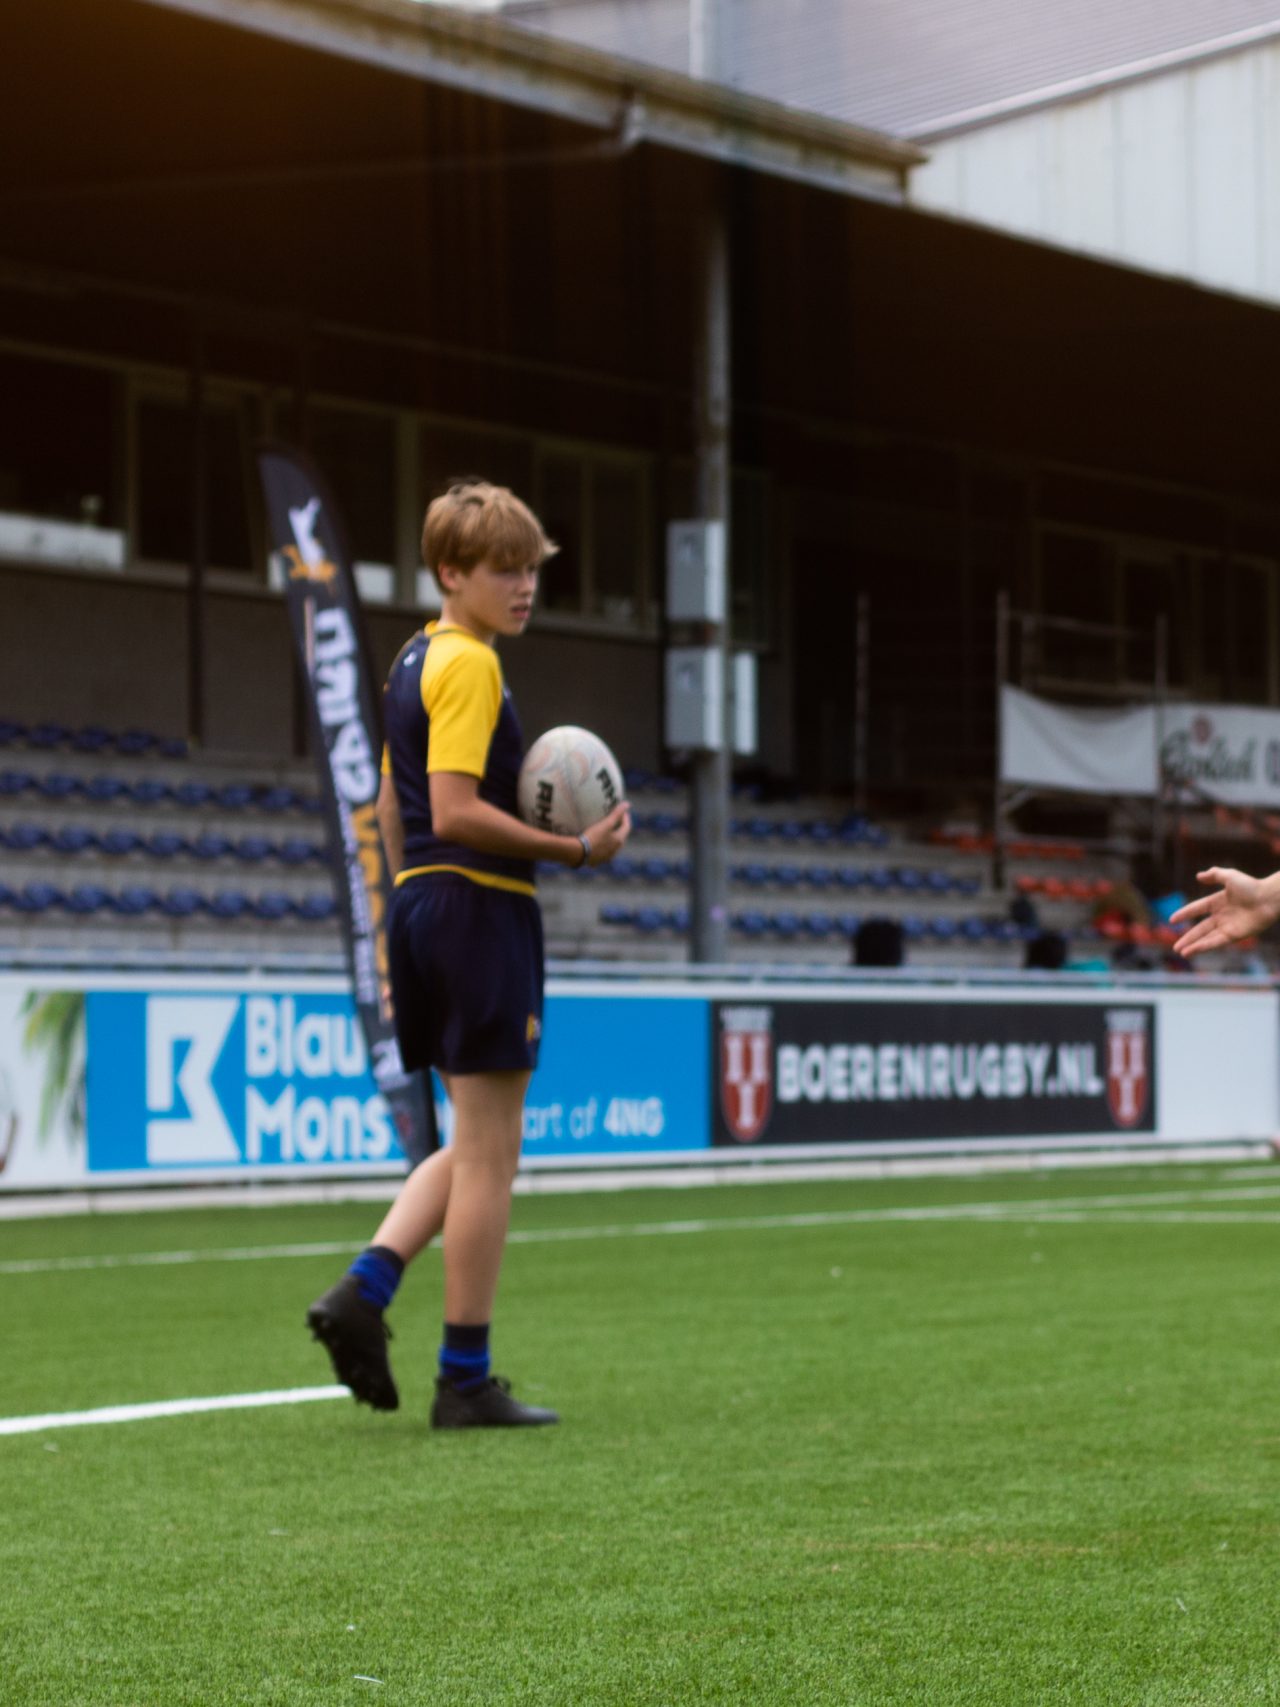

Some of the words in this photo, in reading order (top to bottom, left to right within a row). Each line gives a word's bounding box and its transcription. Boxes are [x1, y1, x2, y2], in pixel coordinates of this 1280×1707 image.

[246, 996, 367, 1078] Blau
[777, 1044, 1104, 1101] BOERENRUGBY.NL
[245, 1083, 392, 1161] Mons
[522, 1103, 563, 1139] art
[569, 1096, 598, 1139] of
[603, 1097, 665, 1137] 4NG
